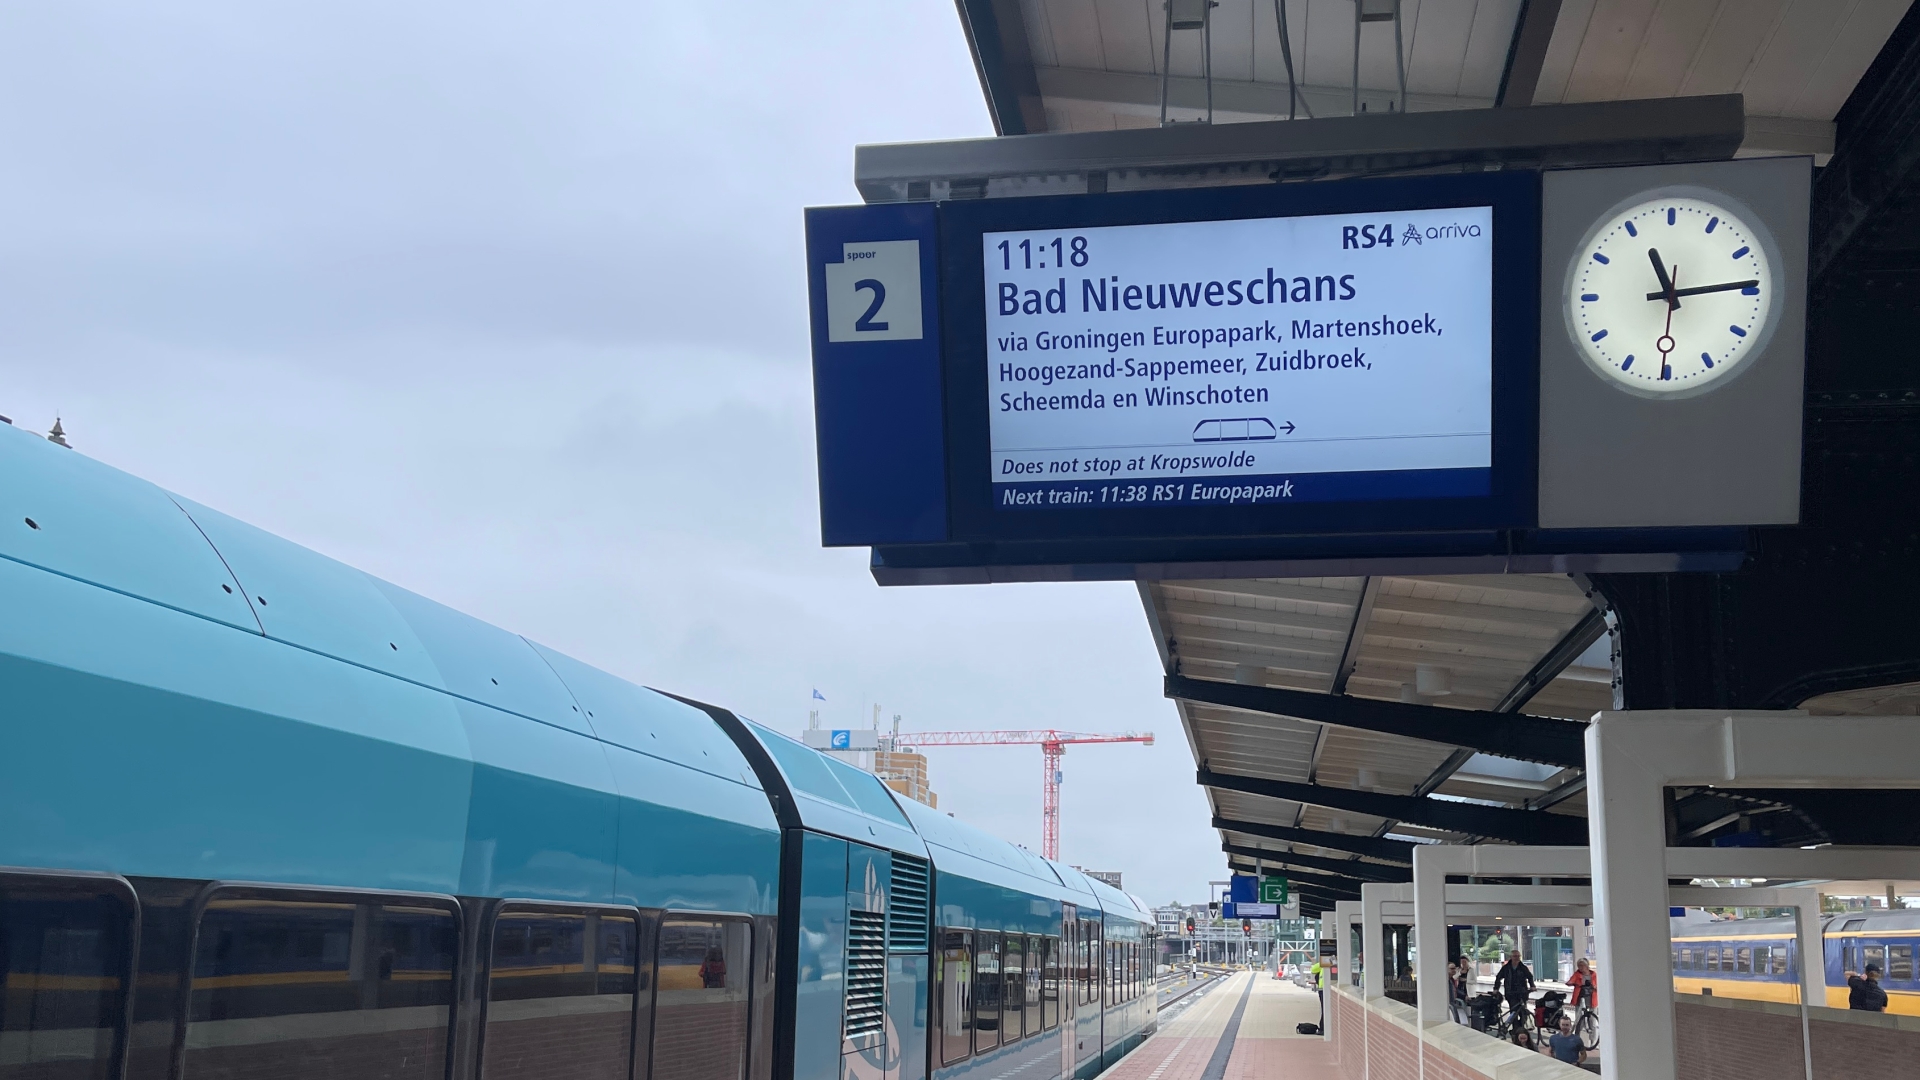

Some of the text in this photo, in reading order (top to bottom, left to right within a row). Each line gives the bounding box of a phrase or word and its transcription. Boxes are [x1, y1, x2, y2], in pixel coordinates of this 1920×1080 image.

[1342, 222, 1481, 250] RS4 arriva
[847, 251, 876, 261] spoor
[997, 235, 1089, 271] 11:18
[854, 278, 889, 332] 2
[998, 267, 1356, 317] Bad Nieuweschans
[998, 312, 1443, 354] via Groningen Europapark, Martenshoek,
[999, 346, 1372, 386] Hoogezand-Sappemeer, Zuidbroek,
[1000, 383, 1269, 412] Scheemda en Winschoten
[1002, 450, 1256, 477] Does not stop at Kropswolde
[1003, 480, 1294, 505] Next train: 11:38 RS1 Europapark
